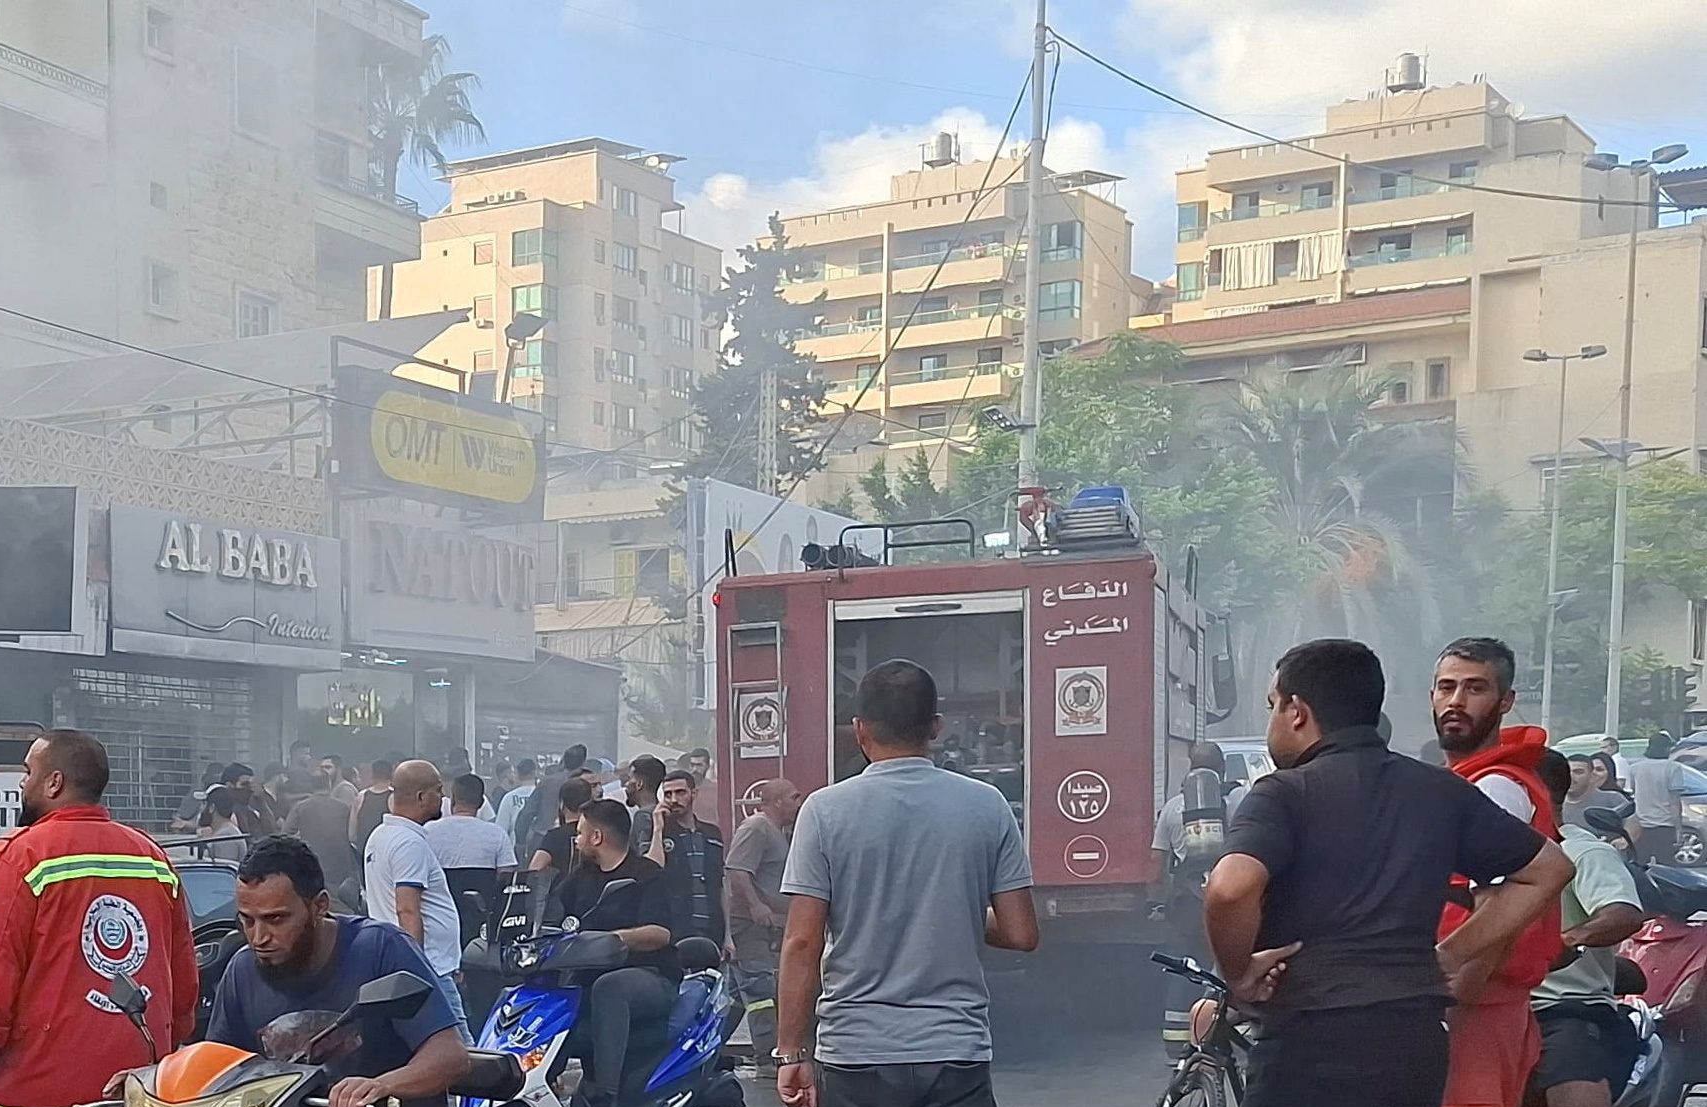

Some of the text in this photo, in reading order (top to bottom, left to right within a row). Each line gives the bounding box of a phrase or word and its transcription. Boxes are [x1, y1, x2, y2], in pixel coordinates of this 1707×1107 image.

[384, 415, 446, 466] OMT
[155, 519, 319, 590] AL BABA
[1067, 782, 1103, 799] صيدا
[1068, 800, 1100, 816] ١٢٥
[501, 915, 527, 928] GIVI
